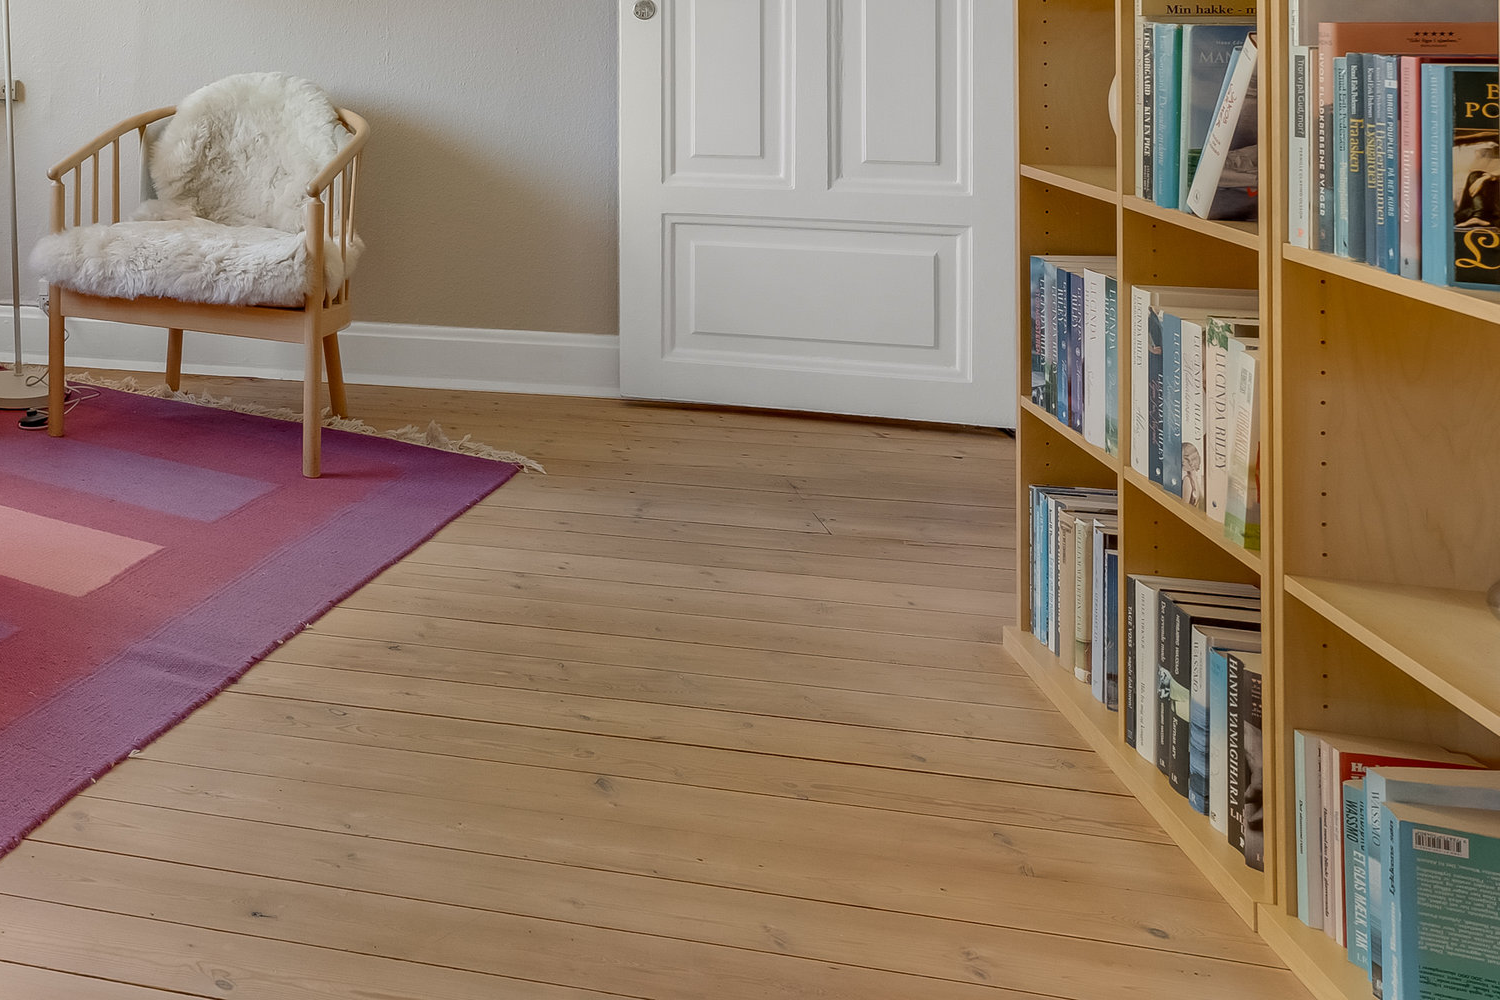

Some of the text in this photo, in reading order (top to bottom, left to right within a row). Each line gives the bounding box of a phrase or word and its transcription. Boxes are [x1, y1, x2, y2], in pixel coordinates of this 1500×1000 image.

[1166, 4, 1192, 15] Min
[1196, 4, 1234, 15] hakke
[1296, 84, 1304, 94] på
[1350, 64, 1358, 80] Knud
[1339, 112, 1348, 152] Pedersen
[1350, 118, 1364, 173] Fra asken
[1386, 122, 1394, 160] POUPLIER
[1403, 150, 1414, 223] intermezzo
[1108, 289, 1116, 350] LUCINDA
[1214, 352, 1226, 472] LUCINDA RILEY
[1230, 658, 1238, 708] HANYA
[1230, 710, 1238, 806] YANAGIHARA
[1346, 800, 1358, 842] WASSMO
[1370, 790, 1380, 846] WASSMO
[1353, 850, 1366, 864] ET
[1388, 844, 1396, 896] Lykkens
[1354, 866, 1368, 890] GLAS
[1355, 892, 1368, 926] MÆLK,
[1355, 930, 1368, 950] TAK
